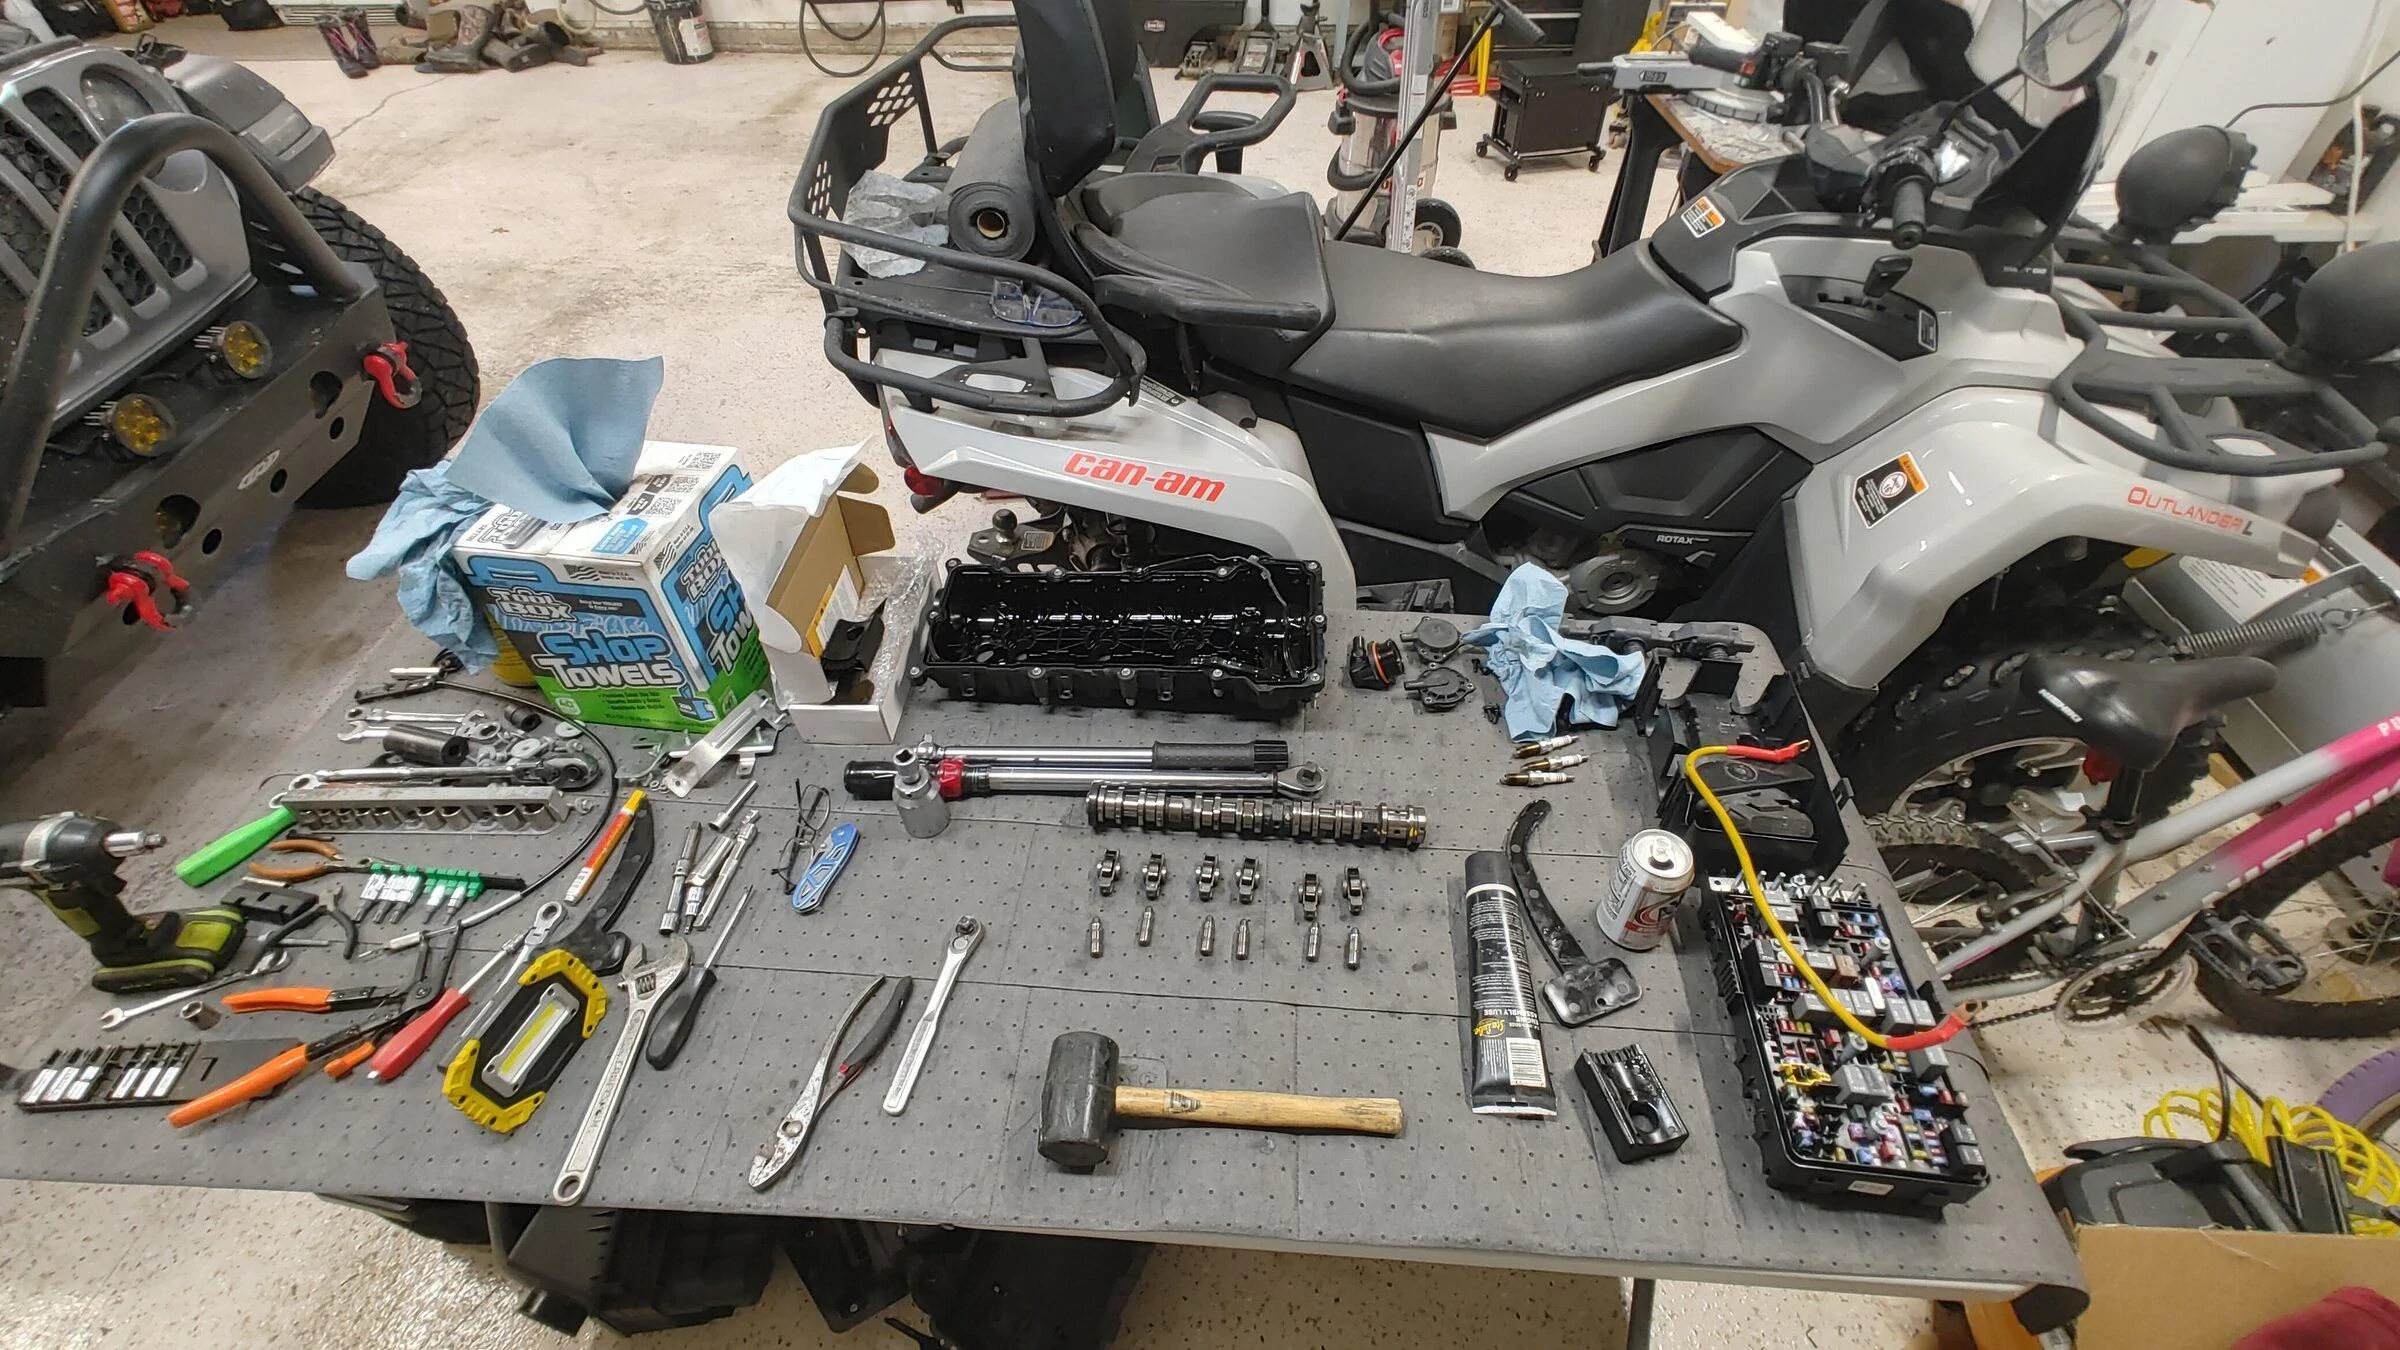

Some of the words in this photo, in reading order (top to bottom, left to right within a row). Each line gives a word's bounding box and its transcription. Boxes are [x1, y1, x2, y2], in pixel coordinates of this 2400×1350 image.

[1064, 452, 1226, 502] can-am
[2127, 486, 2243, 530] OUTLANDER
[1656, 534, 1694, 545] ROTAX
[490, 587, 560, 606] TOOL
[499, 601, 573, 620] BOX
[541, 629, 669, 666] SHOP
[536, 656, 685, 689] TOWELS
